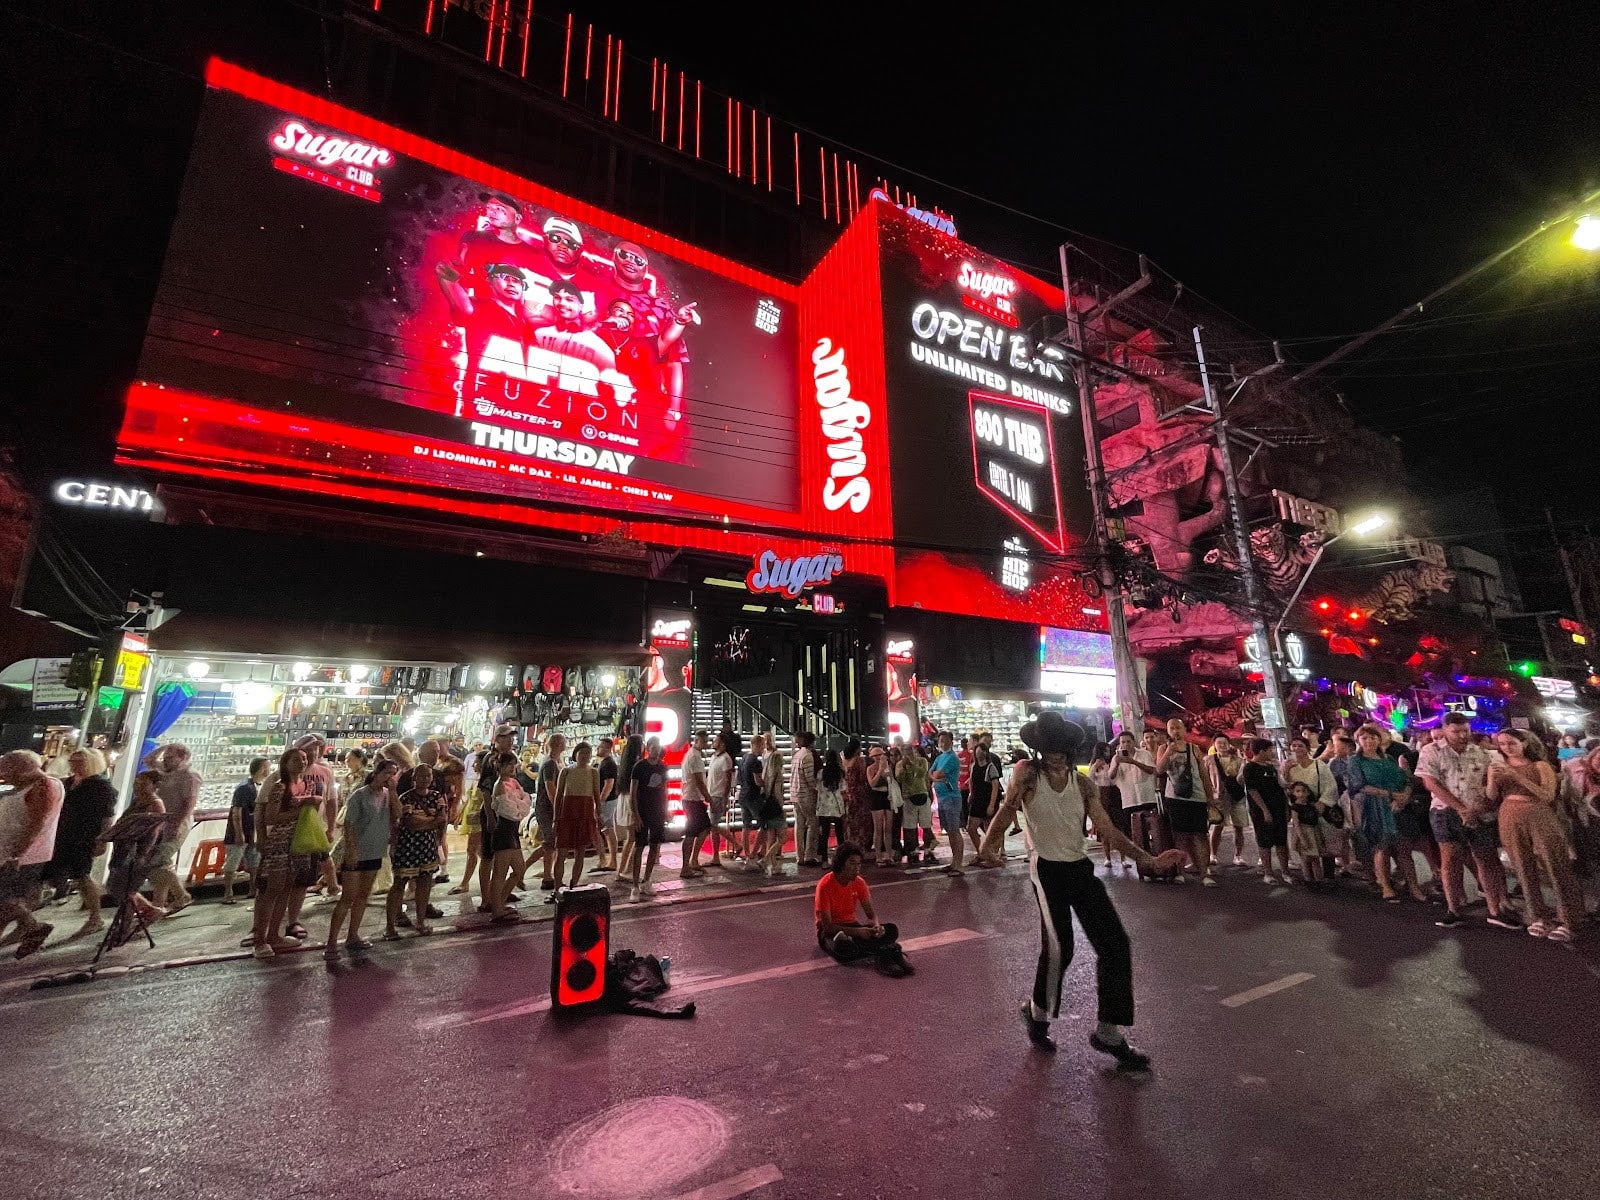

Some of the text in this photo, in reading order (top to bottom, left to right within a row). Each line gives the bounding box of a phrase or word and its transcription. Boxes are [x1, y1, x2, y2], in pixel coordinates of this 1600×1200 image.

[273, 122, 392, 167] Sugar
[347, 166, 374, 186] CLUB
[957, 261, 1016, 299] Sugar
[754, 317, 778, 335] HOP
[756, 308, 780, 326] HIP
[911, 303, 1004, 361] OPEN
[910, 341, 1008, 391] UNLIMITED
[474, 373, 639, 430] FUZION
[470, 421, 636, 476] THURSDAY
[812, 337, 872, 514] Sugar
[974, 408, 1045, 465] 800 THB
[413, 445, 673, 502] DJ LEOMINATI MC DAX LIL JAMES CHRIS YAW
[752, 549, 844, 596] Sugar
[1002, 556, 1029, 576] HIP
[1002, 570, 1029, 592] HOP
[813, 593, 835, 614] CLUB
